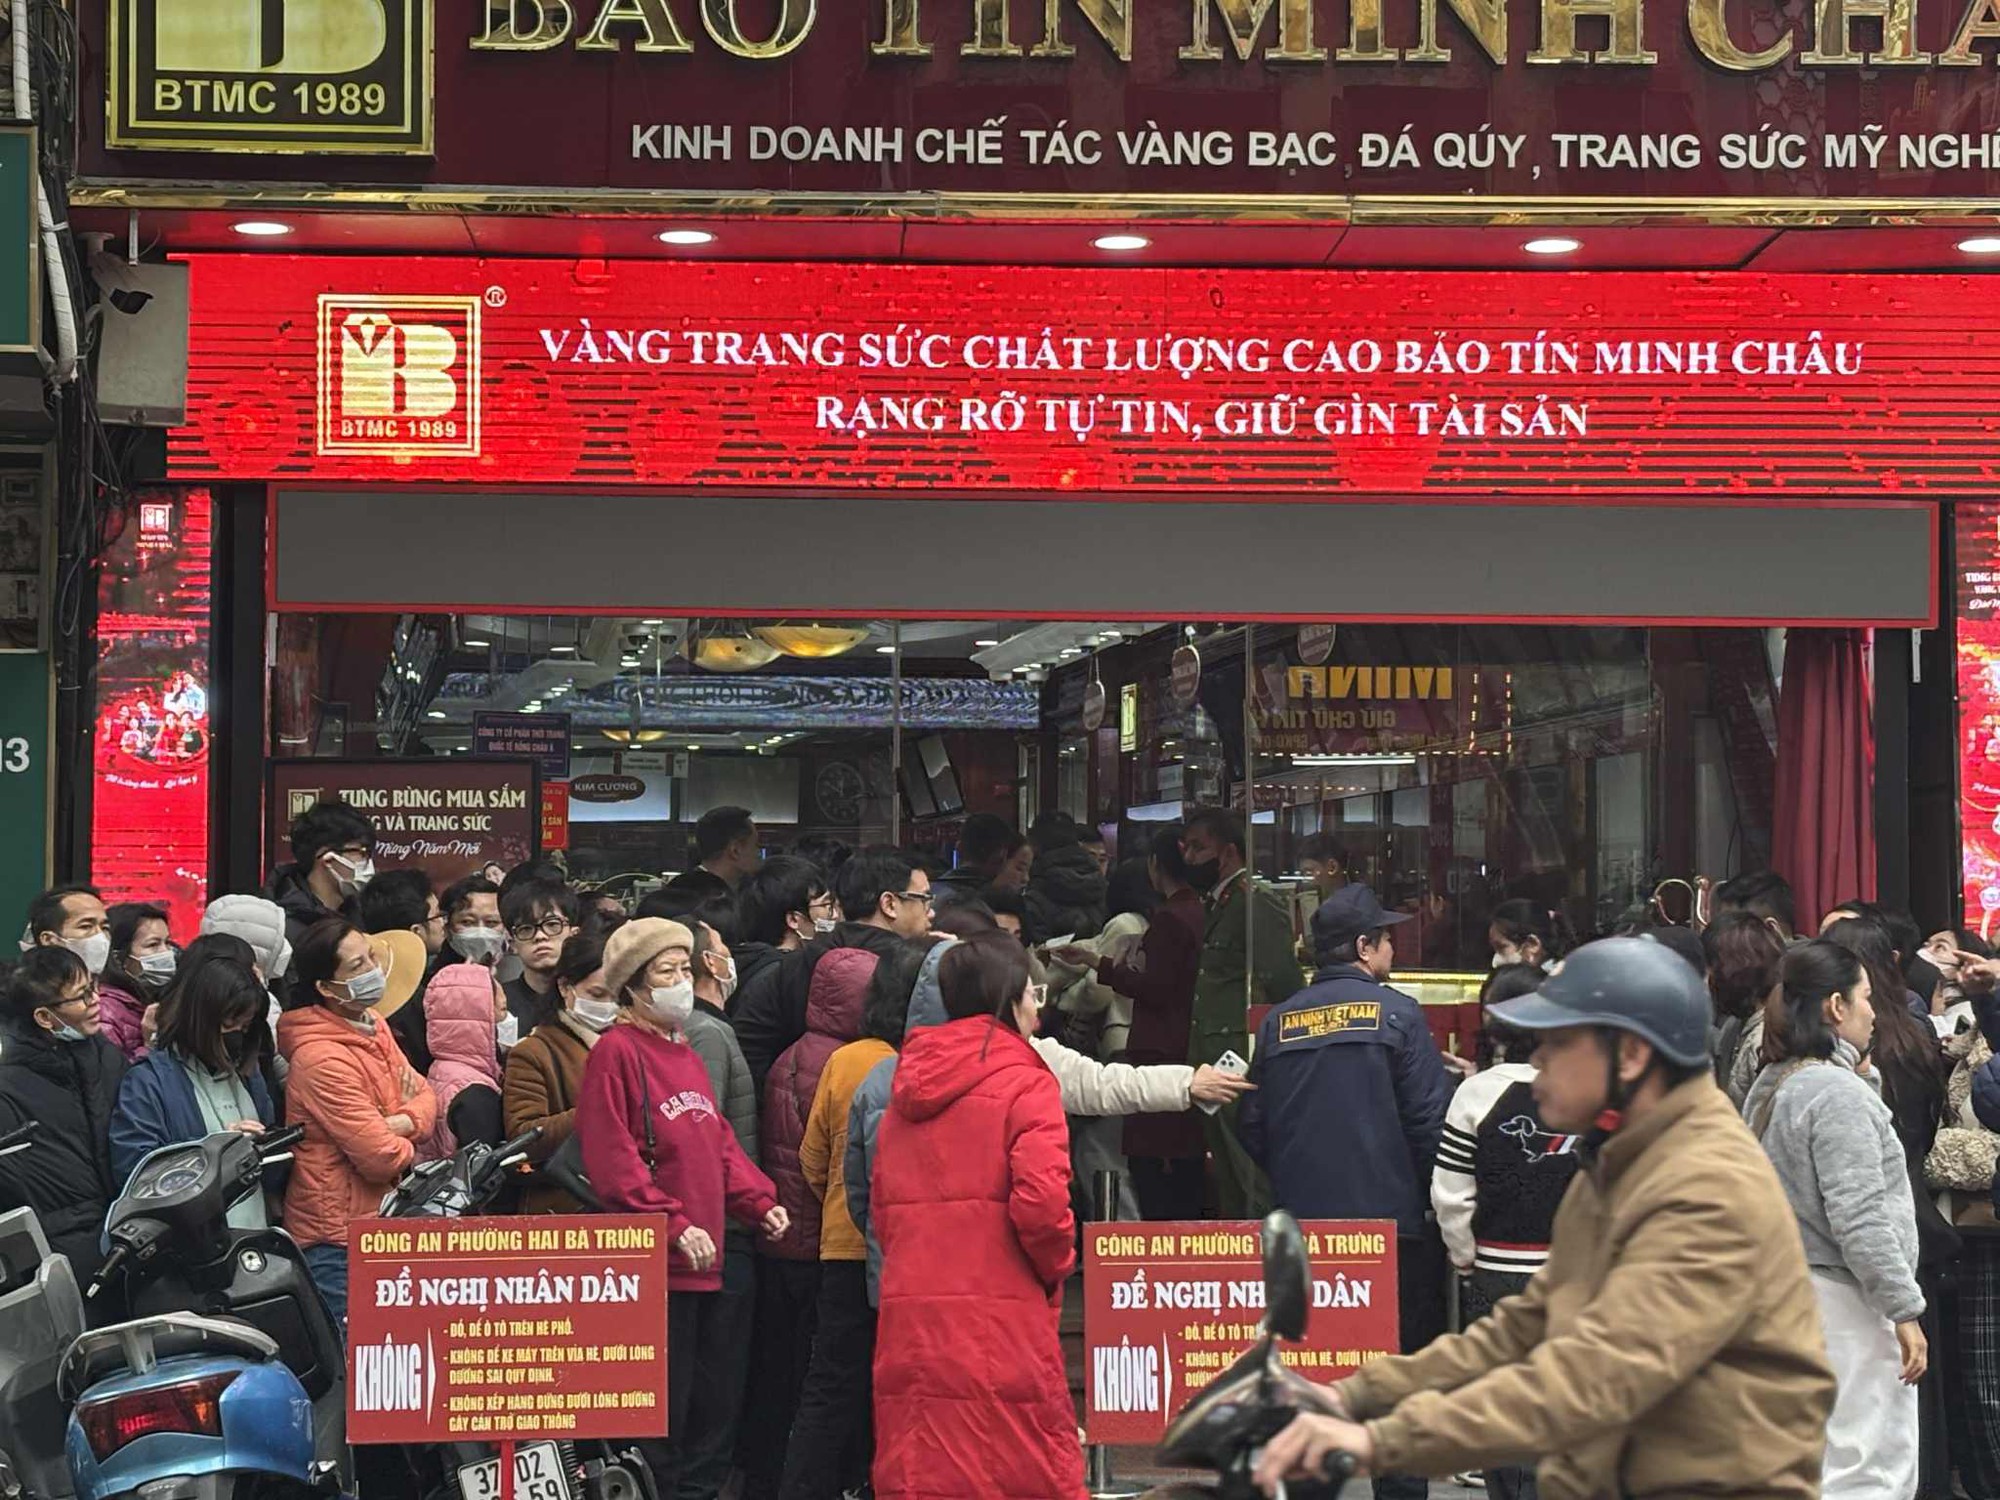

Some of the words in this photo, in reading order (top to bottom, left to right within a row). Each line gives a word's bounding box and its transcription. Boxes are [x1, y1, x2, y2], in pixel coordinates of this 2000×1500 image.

[154, 79, 277, 114] BTMC
[293, 82, 386, 116] 1989
[631, 124, 731, 160] KINH
[749, 125, 903, 163] DOANH
[916, 115, 1008, 165] CHẾ
[1020, 120, 1102, 165] TÁC
[1117, 120, 1233, 165] VÀNG
[1359, 124, 1421, 168] ĐÁ
[1552, 134, 1700, 169] TRANG
[1718, 123, 1806, 169] SỨC
[1824, 125, 1888, 168] MỸ
[539, 318, 671, 364] VÀNG
[684, 331, 845, 366] TRANG
[858, 325, 952, 368] SỨC
[962, 328, 1093, 371] CHẤT
[1105, 332, 1270, 380] LƯỢNG
[1282, 338, 1382, 373] CAO
[1393, 331, 1492, 374] BẢO
[1501, 330, 1580, 374] TÍN
[1594, 340, 1720, 375] MINH
[1731, 330, 1865, 375] CHÂU
[340, 420, 399, 438] BTMC
[407, 420, 457, 438] 1989
[815, 396, 946, 439] RẠNG
[960, 391, 1027, 433] RỠ
[1036, 394, 1105, 442] TỰ
[1112, 398, 1202, 442] TIN,
[1214, 393, 1306, 435] GIỮ
[1314, 393, 1396, 436] GÌN
[1409, 394, 1487, 436] TÀI
[1500, 394, 1589, 437] SẢN
[392, 786, 441, 808] BỪNG
[447, 789, 485, 808] MUA
[489, 783, 527, 808] SẮM
[574, 783, 595, 792] KIM
[386, 812, 406, 832] VÀ
[409, 815, 459, 832] TRANG
[463, 813, 492, 832] SỨC
[1283, 1014, 1300, 1030] AN
[1349, 1004, 1377, 1019] NAM
[360, 1230, 412, 1253] CÔNG
[417, 1232, 441, 1253] AN
[448, 1227, 523, 1251] PHƯỜNG
[528, 1230, 559, 1251] HAI
[565, 1228, 589, 1250] BÀ
[595, 1226, 655, 1249] TRƯNG
[1096, 1234, 1145, 1257] CÔNG
[1151, 1236, 1174, 1256] AN
[1181, 1233, 1253, 1256] PHƯỜNG
[1326, 1233, 1386, 1255] TRƯNG
[375, 1265, 413, 1307] ĐỀ
[419, 1277, 488, 1313] NGHỊ
[495, 1268, 574, 1305] NHÂN
[580, 1267, 640, 1303] DÂN
[1111, 1268, 1148, 1310] ĐỀ
[1154, 1281, 1222, 1316] NGHỊ
[1228, 1280, 1267, 1309] NH
[1312, 1272, 1371, 1308] DÂN
[494, 1319, 507, 1337] TÔ
[509, 1319, 534, 1337] TRÊN
[1227, 1323, 1241, 1340] TÔ
[450, 1346, 484, 1365] KHÔNG
[502, 1348, 515, 1363] XE
[516, 1345, 539, 1363] MÁY
[540, 1345, 564, 1363] TRÊN
[630, 1344, 655, 1361] LÒNG
[1185, 1349, 1219, 1367] KHÔNG
[355, 1333, 422, 1412] KHÔNG
[486, 1369, 504, 1384] SAI
[505, 1368, 525, 1384] QUY
[1093, 1334, 1159, 1412] KHÔNG
[450, 1394, 484, 1411] KHÔNG
[486, 1392, 505, 1410] XẾP
[507, 1393, 535, 1410] HÀNG
[593, 1391, 619, 1408] LÒNG
[449, 1413, 470, 1432] GÂY
[516, 1413, 540, 1430] GIAO
[542, 1411, 576, 1429] THÔNG
[474, 1462, 499, 1495] 37
